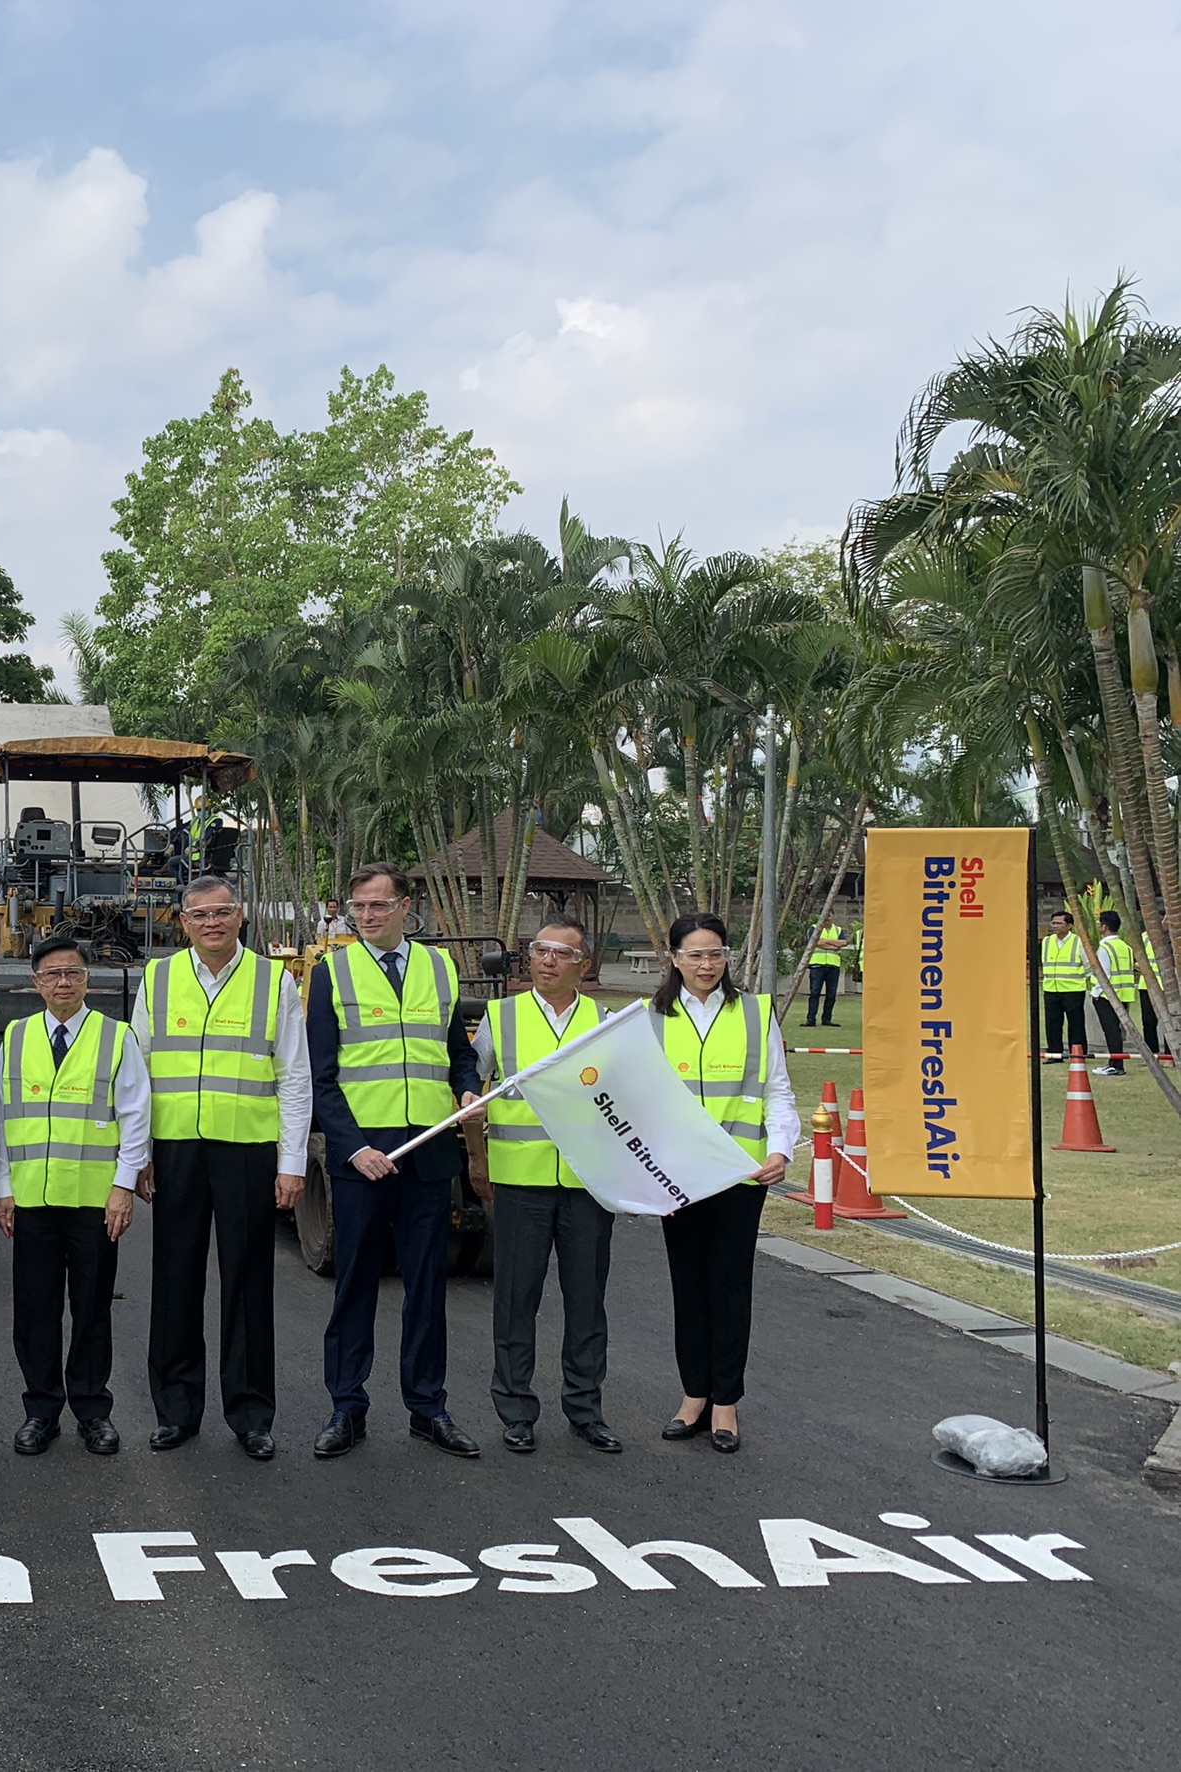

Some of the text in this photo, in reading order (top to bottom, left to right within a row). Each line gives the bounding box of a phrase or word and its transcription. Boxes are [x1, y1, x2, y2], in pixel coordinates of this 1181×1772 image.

[959, 857, 985, 918] Shell
[920, 857, 961, 1179] Bitumen FreshAir
[594, 1092, 691, 1207] Shell Bitumen
[92, 1513, 1093, 1600] FreshAir
